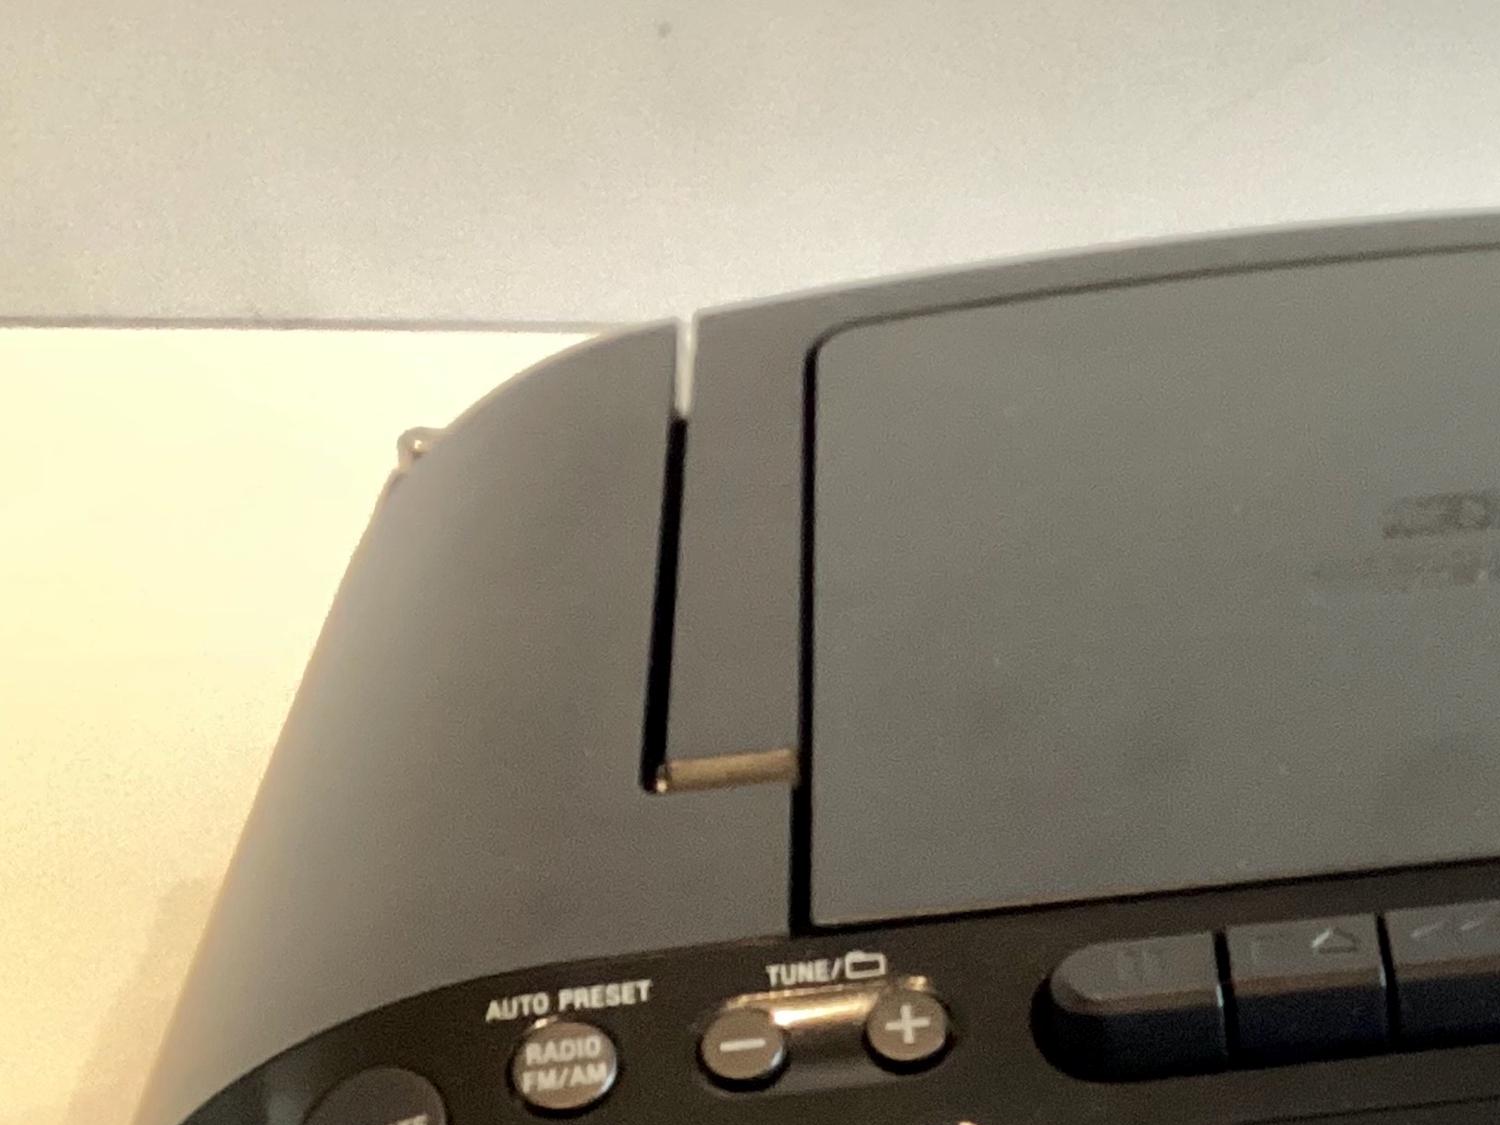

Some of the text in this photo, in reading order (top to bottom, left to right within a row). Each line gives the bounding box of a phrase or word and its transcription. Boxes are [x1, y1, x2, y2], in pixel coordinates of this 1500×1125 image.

[486, 979, 653, 1022] AUTO PRESET
[525, 1034, 602, 1065] RADIO
[522, 1063, 609, 1094] FM/AM
